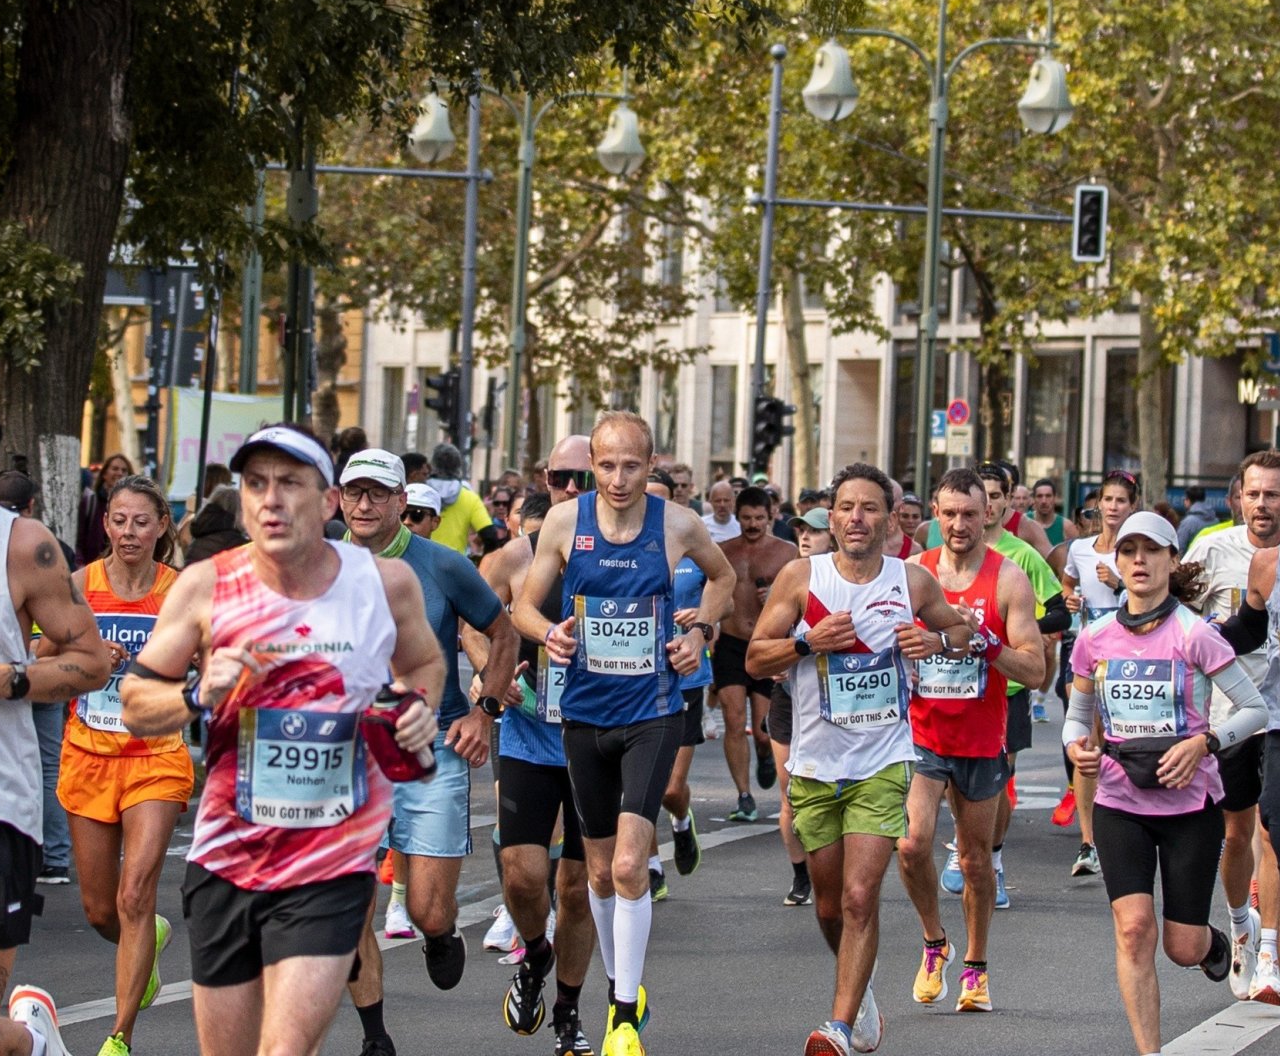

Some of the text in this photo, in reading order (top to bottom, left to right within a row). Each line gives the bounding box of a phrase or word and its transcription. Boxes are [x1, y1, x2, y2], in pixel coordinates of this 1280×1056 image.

[590, 621, 650, 637] 30428
[255, 641, 354, 654] CALIFORNIA
[589, 657, 637, 670] YOU GOT THIS
[836, 671, 891, 692] 16490
[920, 685, 962, 694] YOU GOT THIS
[1110, 684, 1166, 700] 63294
[855, 692, 875, 701] Peter
[88, 714, 118, 726] YOU GOT
[833, 712, 882, 726] YOU GOT THIS
[1124, 723, 1137, 733] GOT
[1139, 724, 1156, 734] THIS
[266, 745, 346, 771] 29915
[255, 804, 325, 820] YOU GOT THIS
